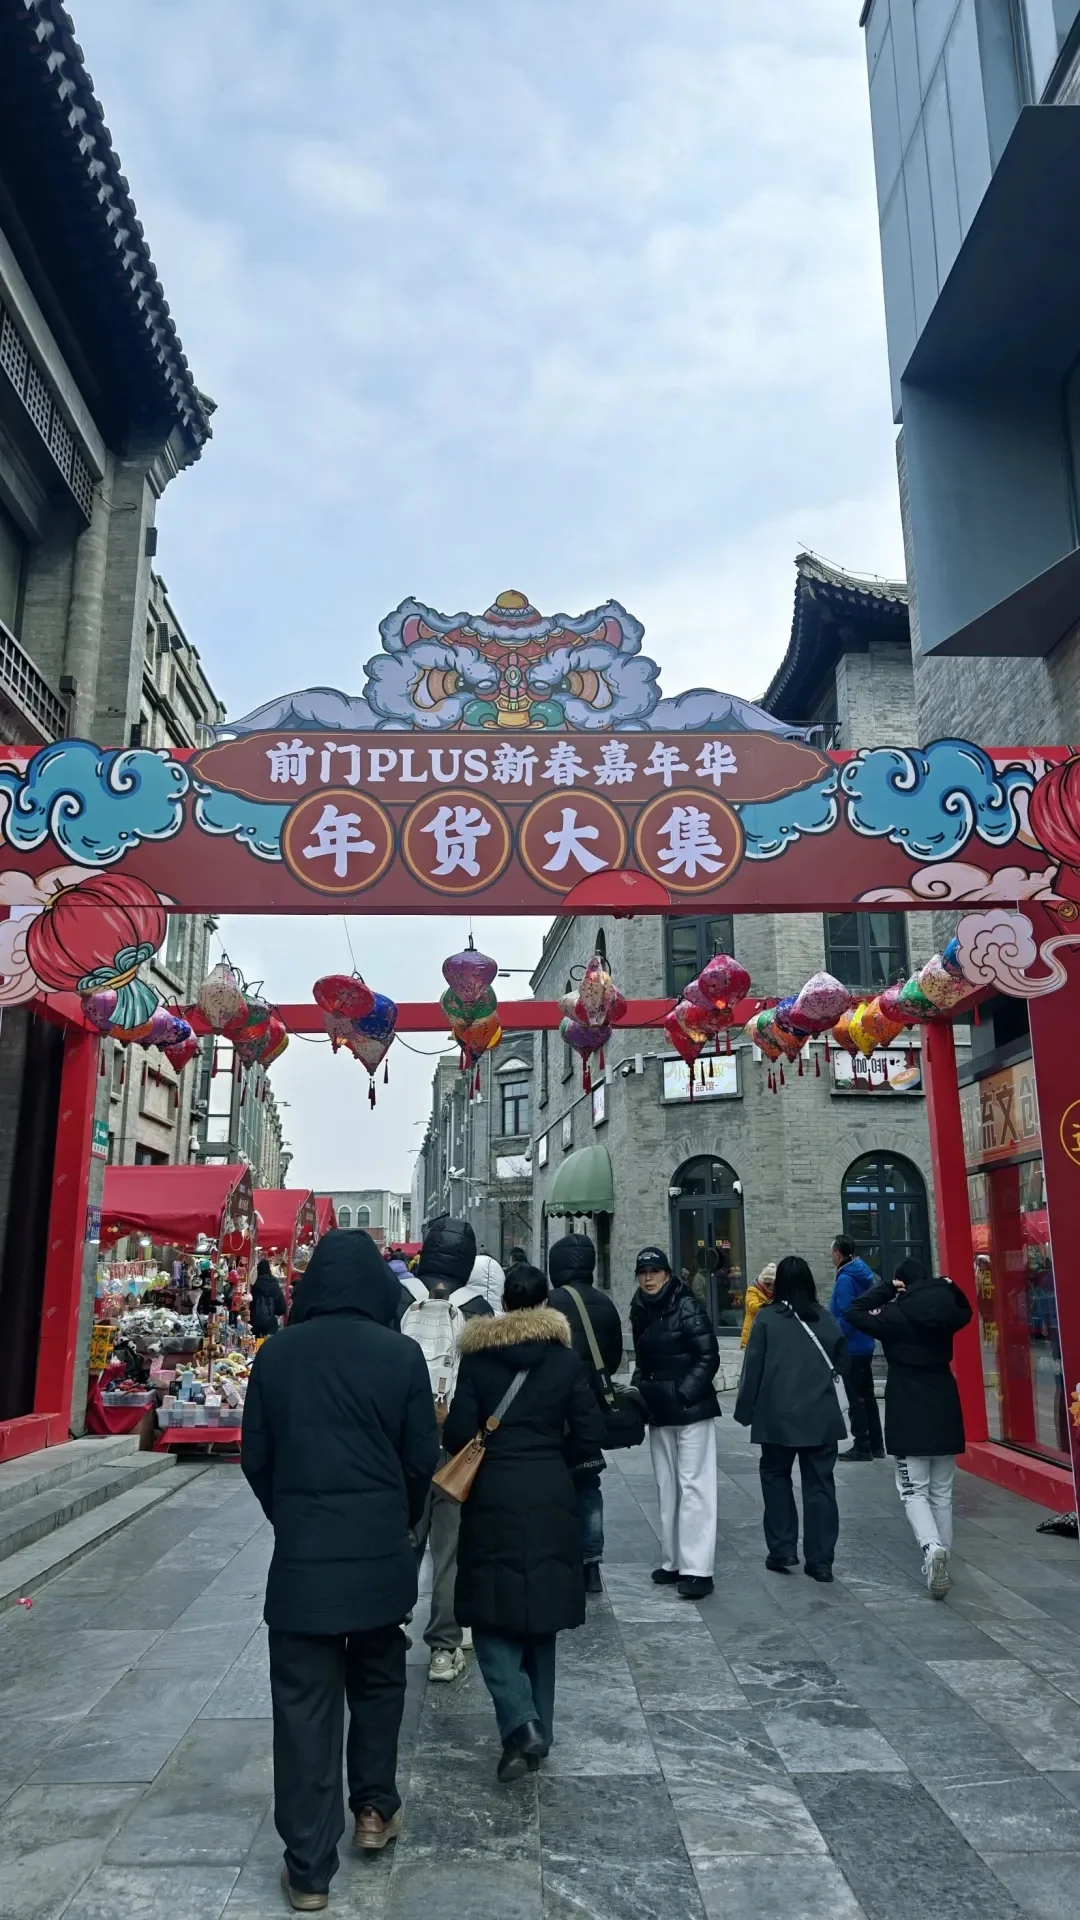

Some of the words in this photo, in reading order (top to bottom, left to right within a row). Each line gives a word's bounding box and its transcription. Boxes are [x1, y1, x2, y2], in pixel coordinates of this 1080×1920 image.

[266, 738, 738, 788] 前门PLUS新春嘉年华
[302, 804, 726, 878] 年货大集
